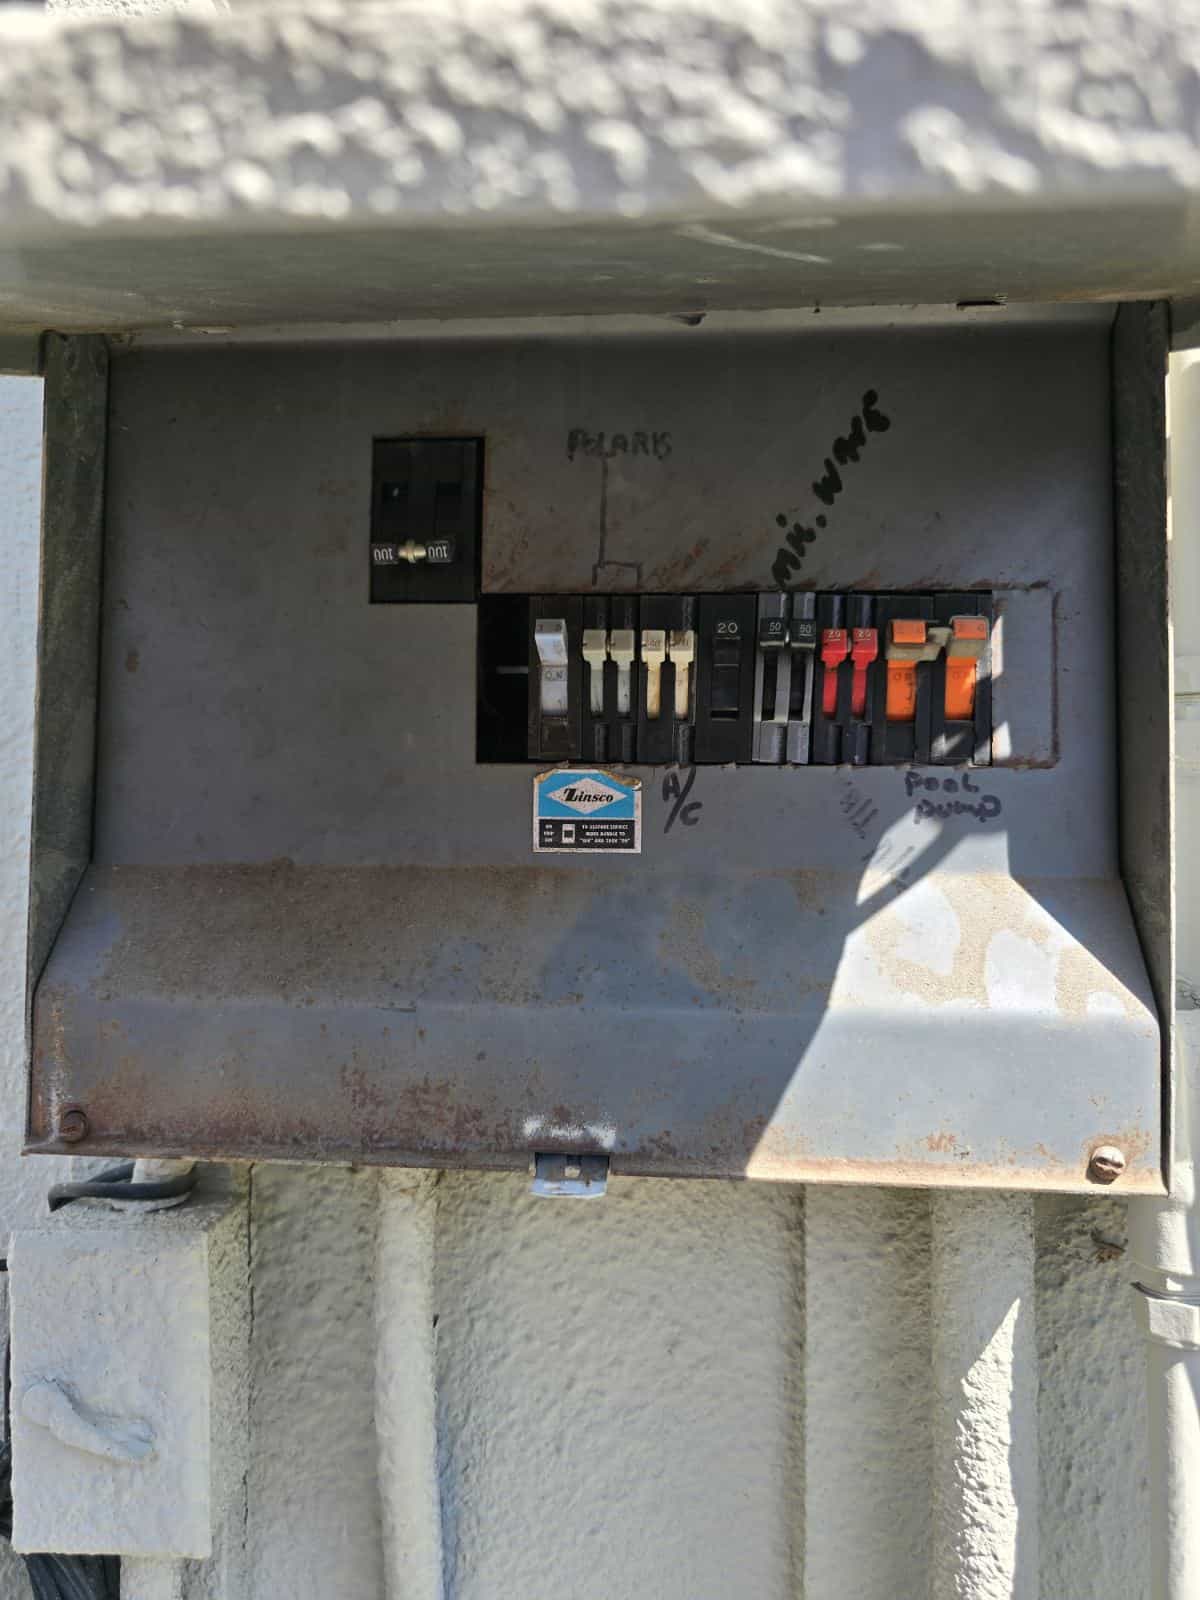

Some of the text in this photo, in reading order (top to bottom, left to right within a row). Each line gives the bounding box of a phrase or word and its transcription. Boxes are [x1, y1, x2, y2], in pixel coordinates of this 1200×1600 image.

[717, 622, 738, 634] 20
[769, 621, 782, 632] 50
[800, 623, 812, 634] 50
